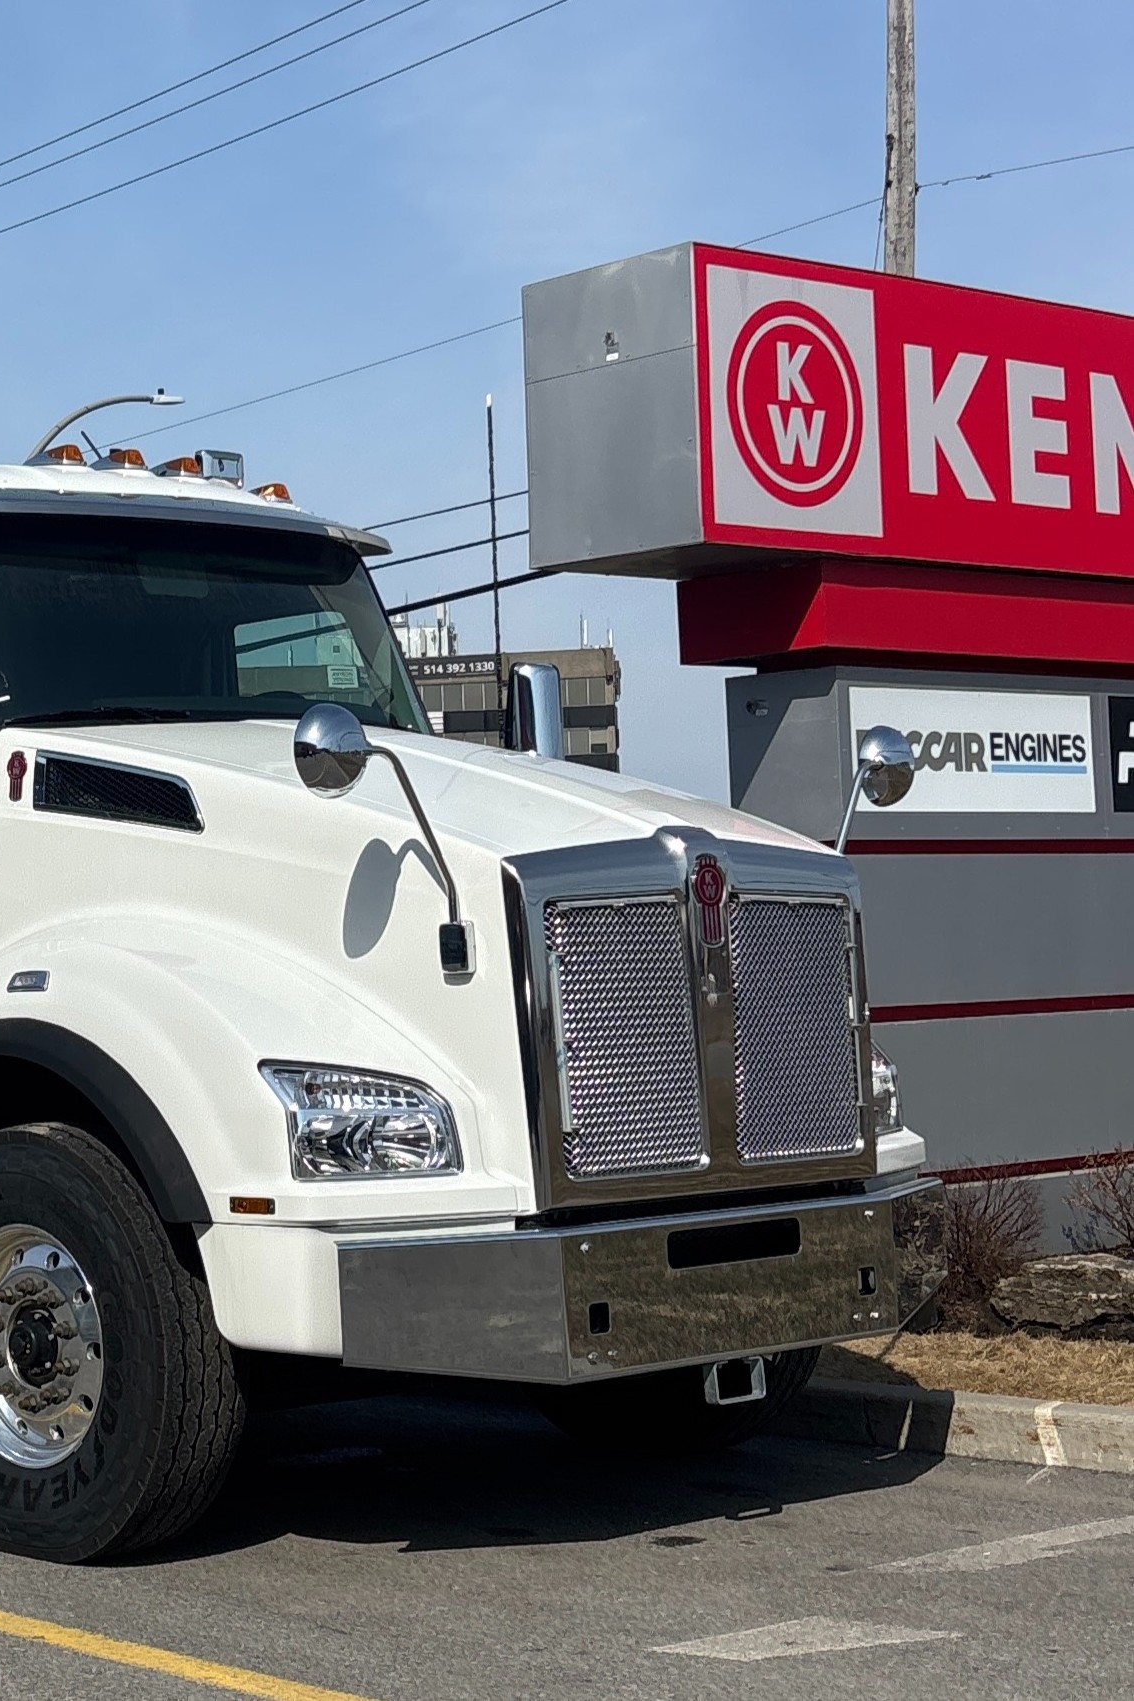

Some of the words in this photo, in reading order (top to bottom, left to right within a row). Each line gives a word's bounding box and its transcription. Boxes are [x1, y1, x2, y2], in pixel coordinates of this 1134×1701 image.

[776, 341, 815, 405] K
[767, 404, 826, 468] W
[903, 343, 1134, 516] KEN
[423, 664, 444, 675] 514
[446, 663, 466, 673] 392
[469, 661, 495, 672] 1330
[856, 729, 988, 773] CCAR
[989, 732, 1087, 763] ENGINES
